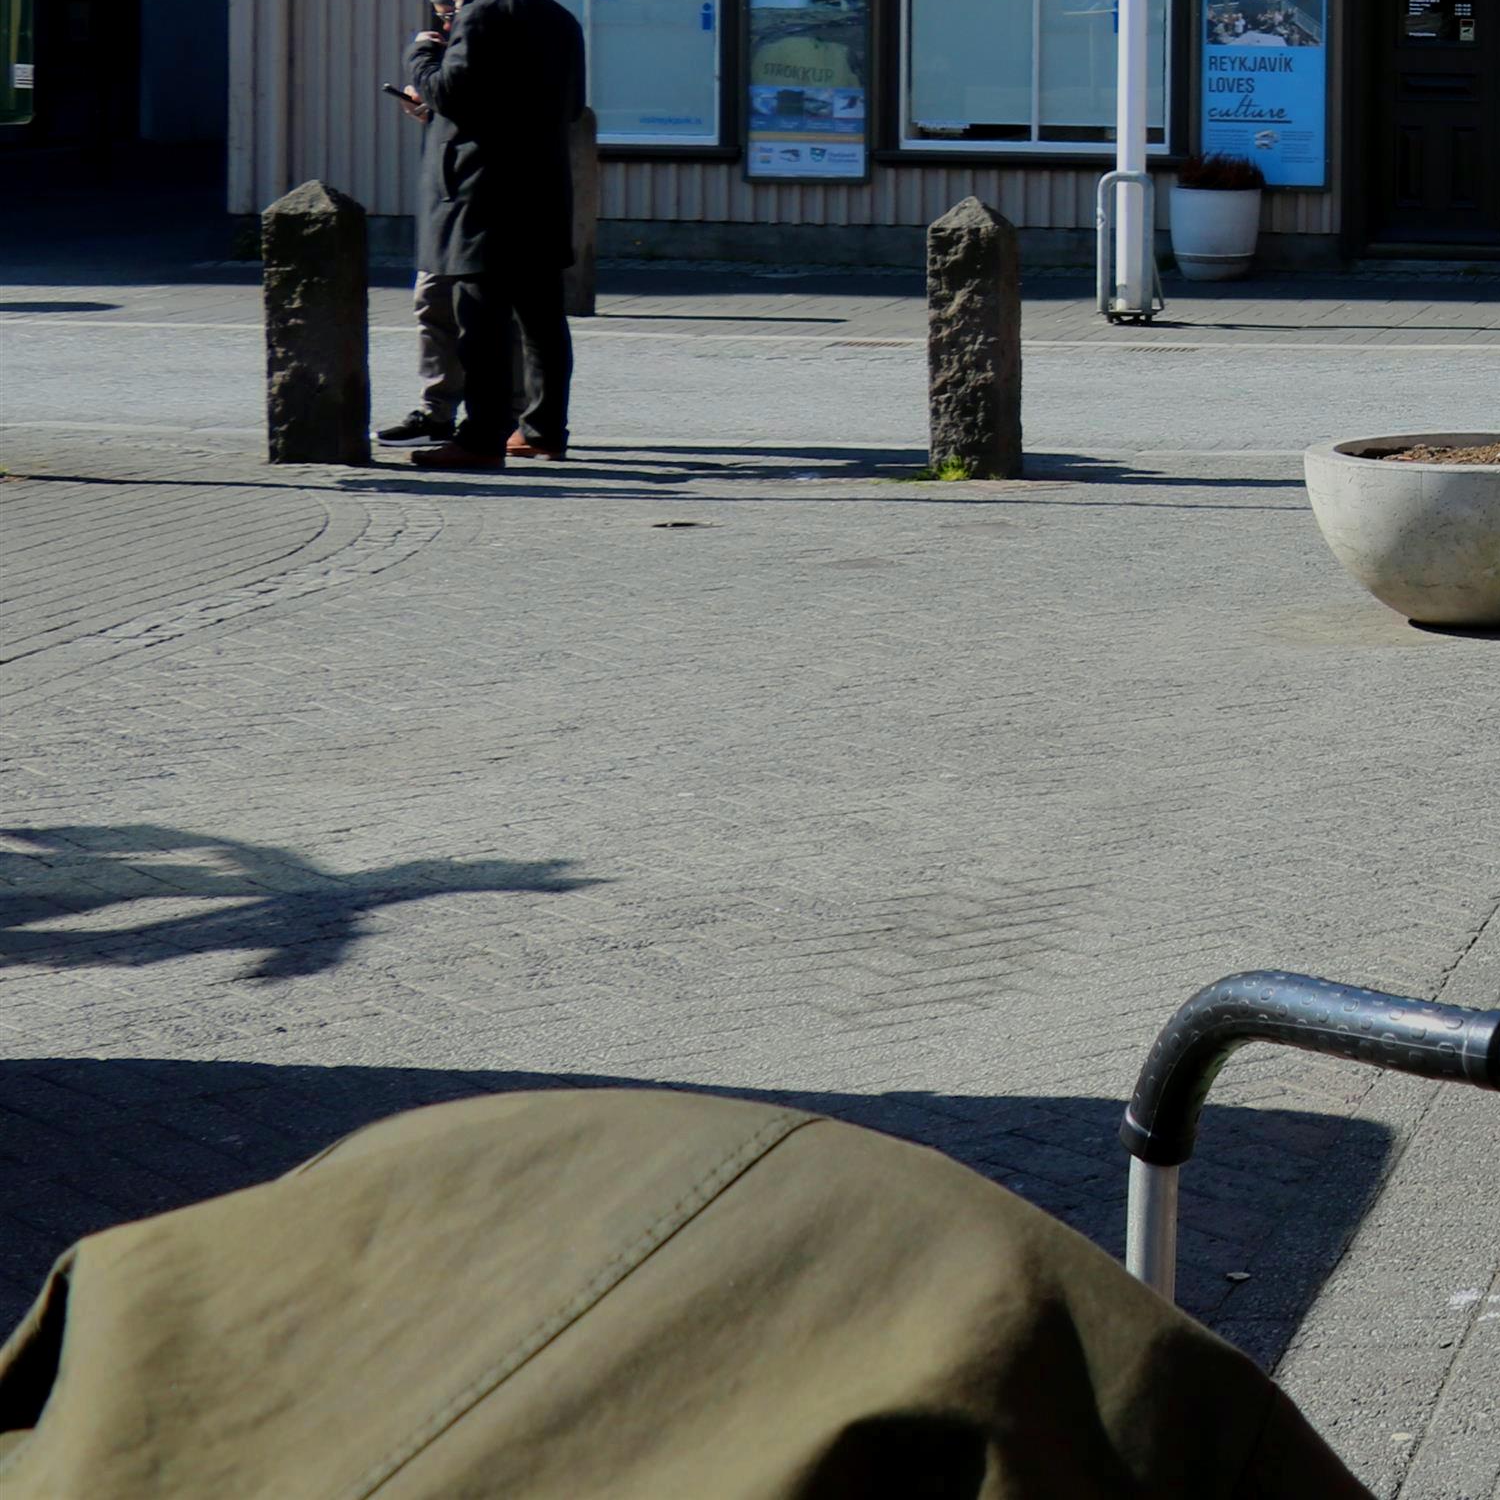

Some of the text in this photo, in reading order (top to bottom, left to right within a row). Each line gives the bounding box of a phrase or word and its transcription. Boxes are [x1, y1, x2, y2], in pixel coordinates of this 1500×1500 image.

[1207, 53, 1294, 73] REYKJAVÍK
[1208, 76, 1255, 94] LOVES
[1207, 93, 1289, 119] culture
